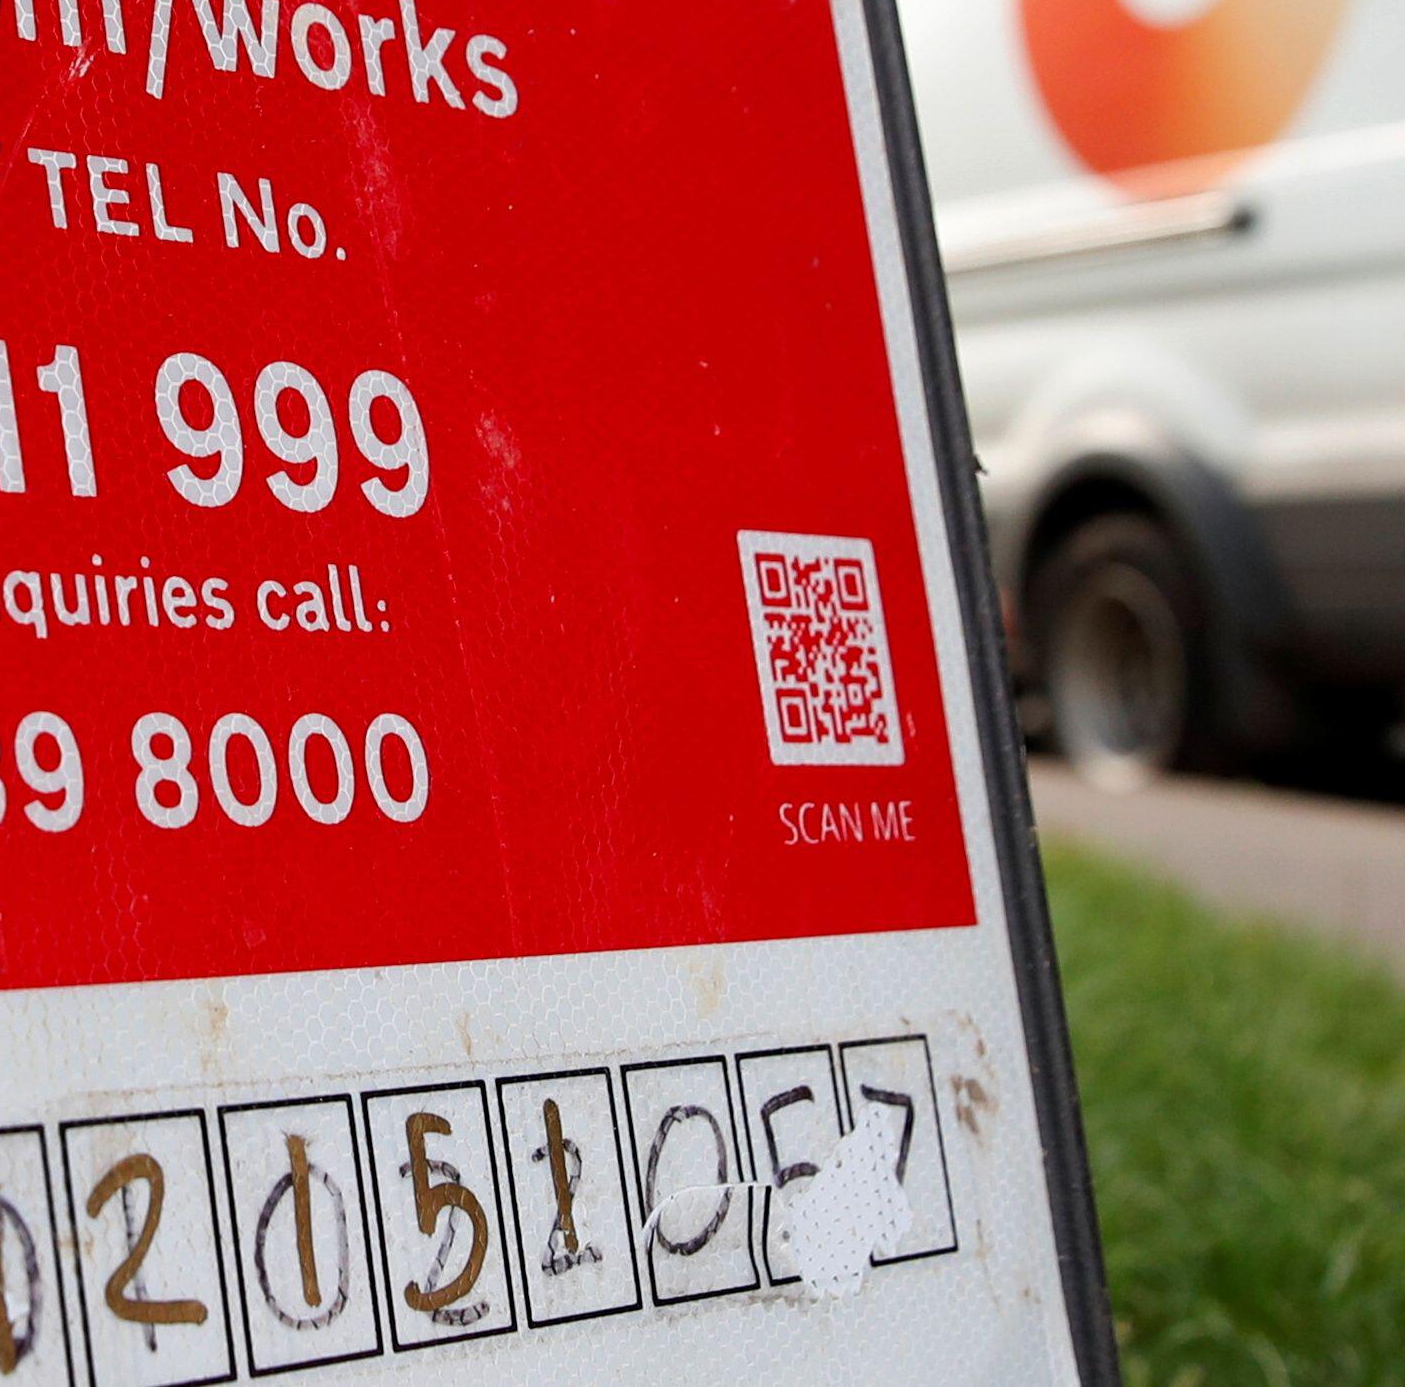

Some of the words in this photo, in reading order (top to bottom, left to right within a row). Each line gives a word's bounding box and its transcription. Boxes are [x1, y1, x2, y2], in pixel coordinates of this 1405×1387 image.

[27, 147, 195, 243] TEL
[217, 171, 351, 263] No.
[153, 351, 430, 519] 999
[257, 564, 390, 634] call:
[131, 712, 429, 829] 8000
[779, 800, 864, 845] SCAN
[871, 800, 916, 842] ME
